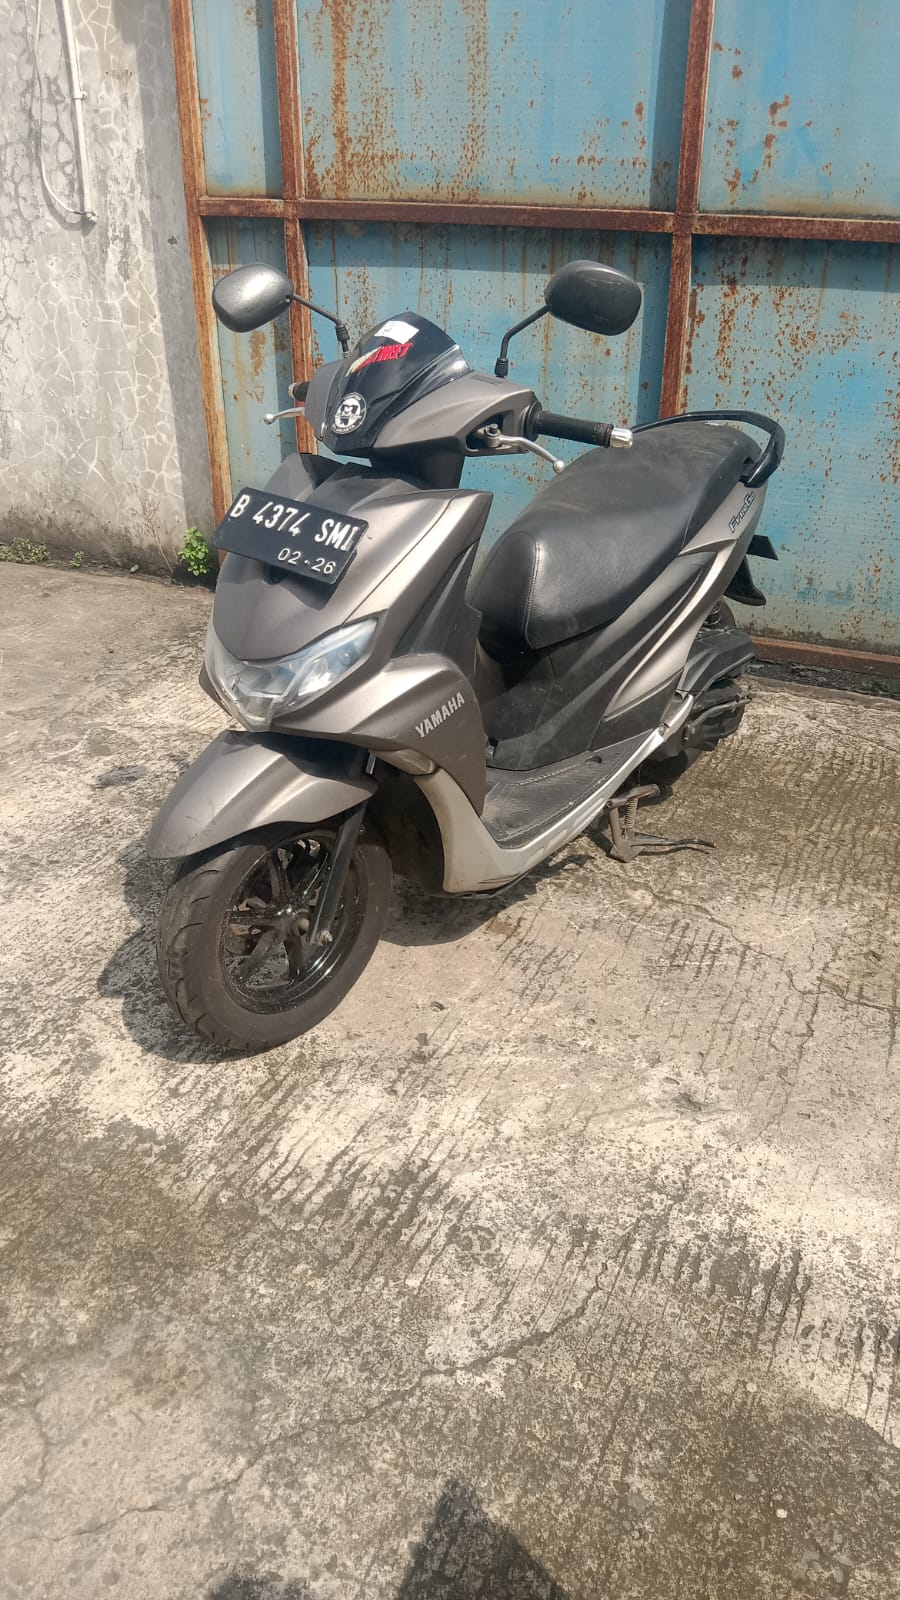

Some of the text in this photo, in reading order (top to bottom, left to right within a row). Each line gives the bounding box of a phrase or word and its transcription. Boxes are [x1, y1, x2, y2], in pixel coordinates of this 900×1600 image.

[230, 494, 251, 518] B
[252, 501, 311, 537] 4374
[415, 691, 466, 738] YAMAHA
